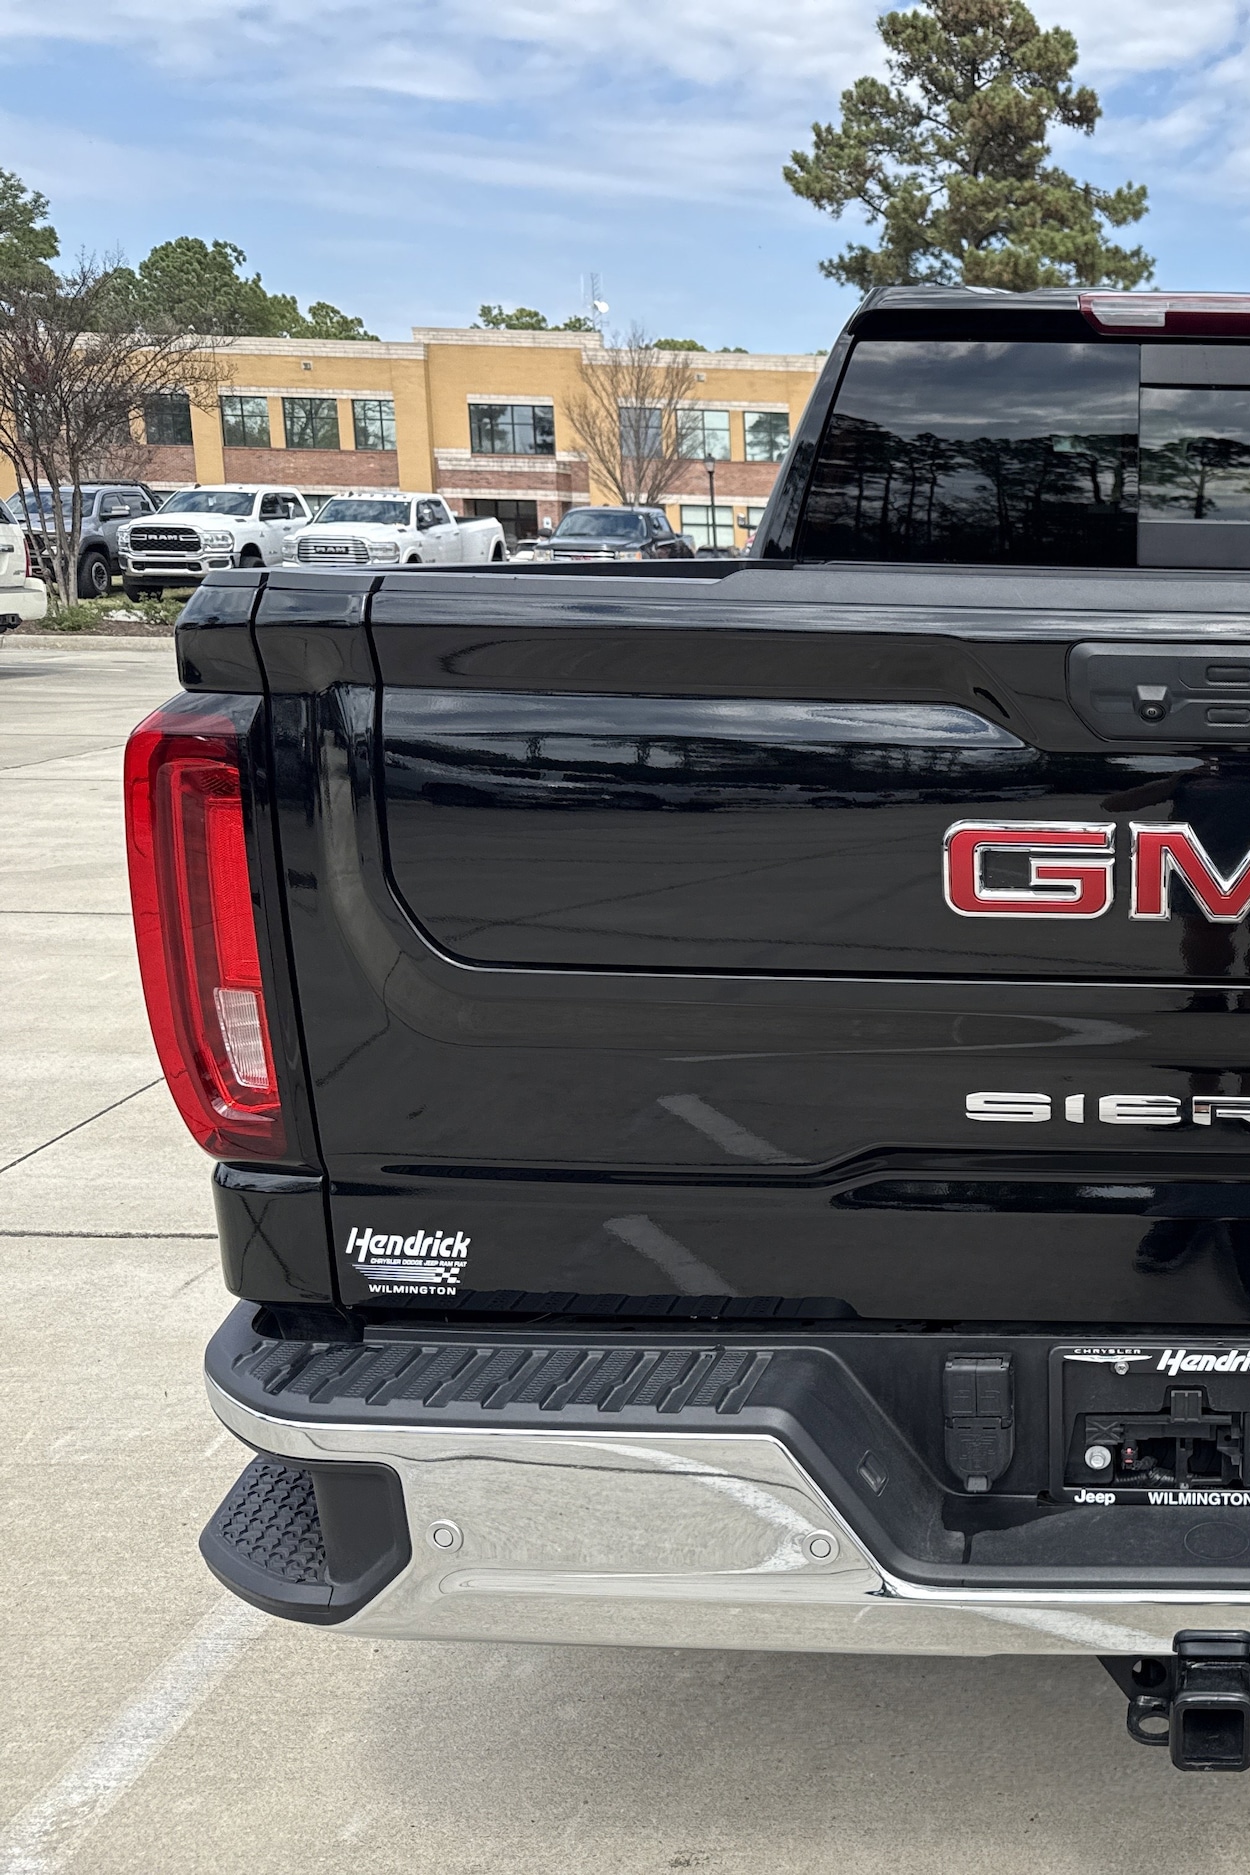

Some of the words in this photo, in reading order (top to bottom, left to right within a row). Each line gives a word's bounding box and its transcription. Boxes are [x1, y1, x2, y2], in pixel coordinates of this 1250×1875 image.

[345, 1227, 472, 1263] Hendrick
[368, 1284, 457, 1296] WILMINGTON
[1074, 1488, 1116, 1506] Jeep
